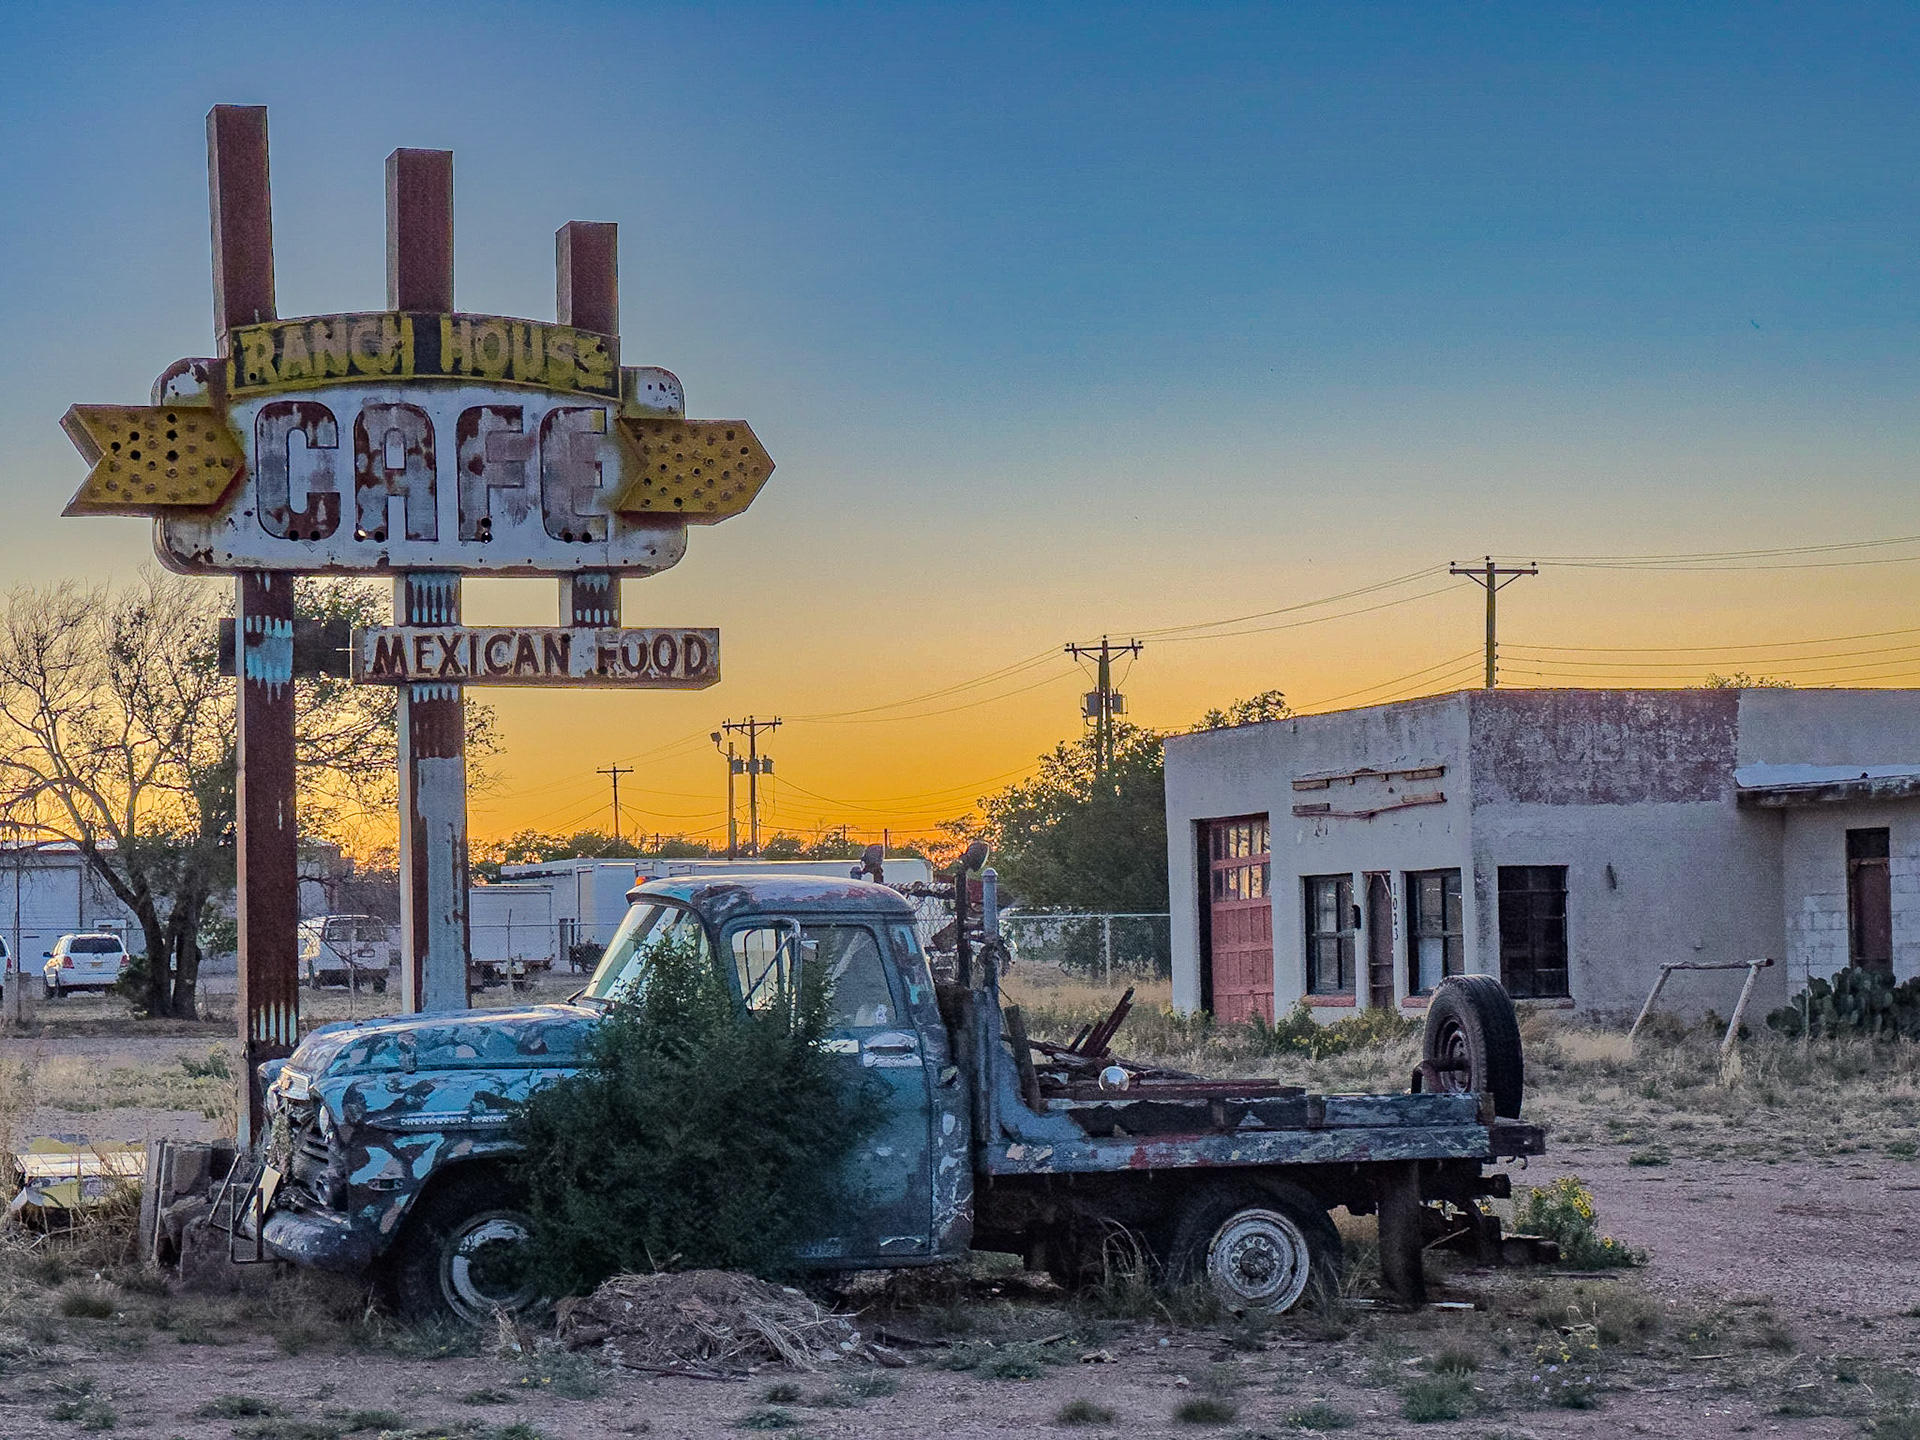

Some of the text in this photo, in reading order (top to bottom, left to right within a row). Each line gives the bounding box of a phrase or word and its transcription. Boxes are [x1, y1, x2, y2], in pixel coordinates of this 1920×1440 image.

[238, 312, 415, 384] RANCH
[254, 400, 609, 542] CAFE
[371, 631, 709, 677] MEXICAN FOOD
